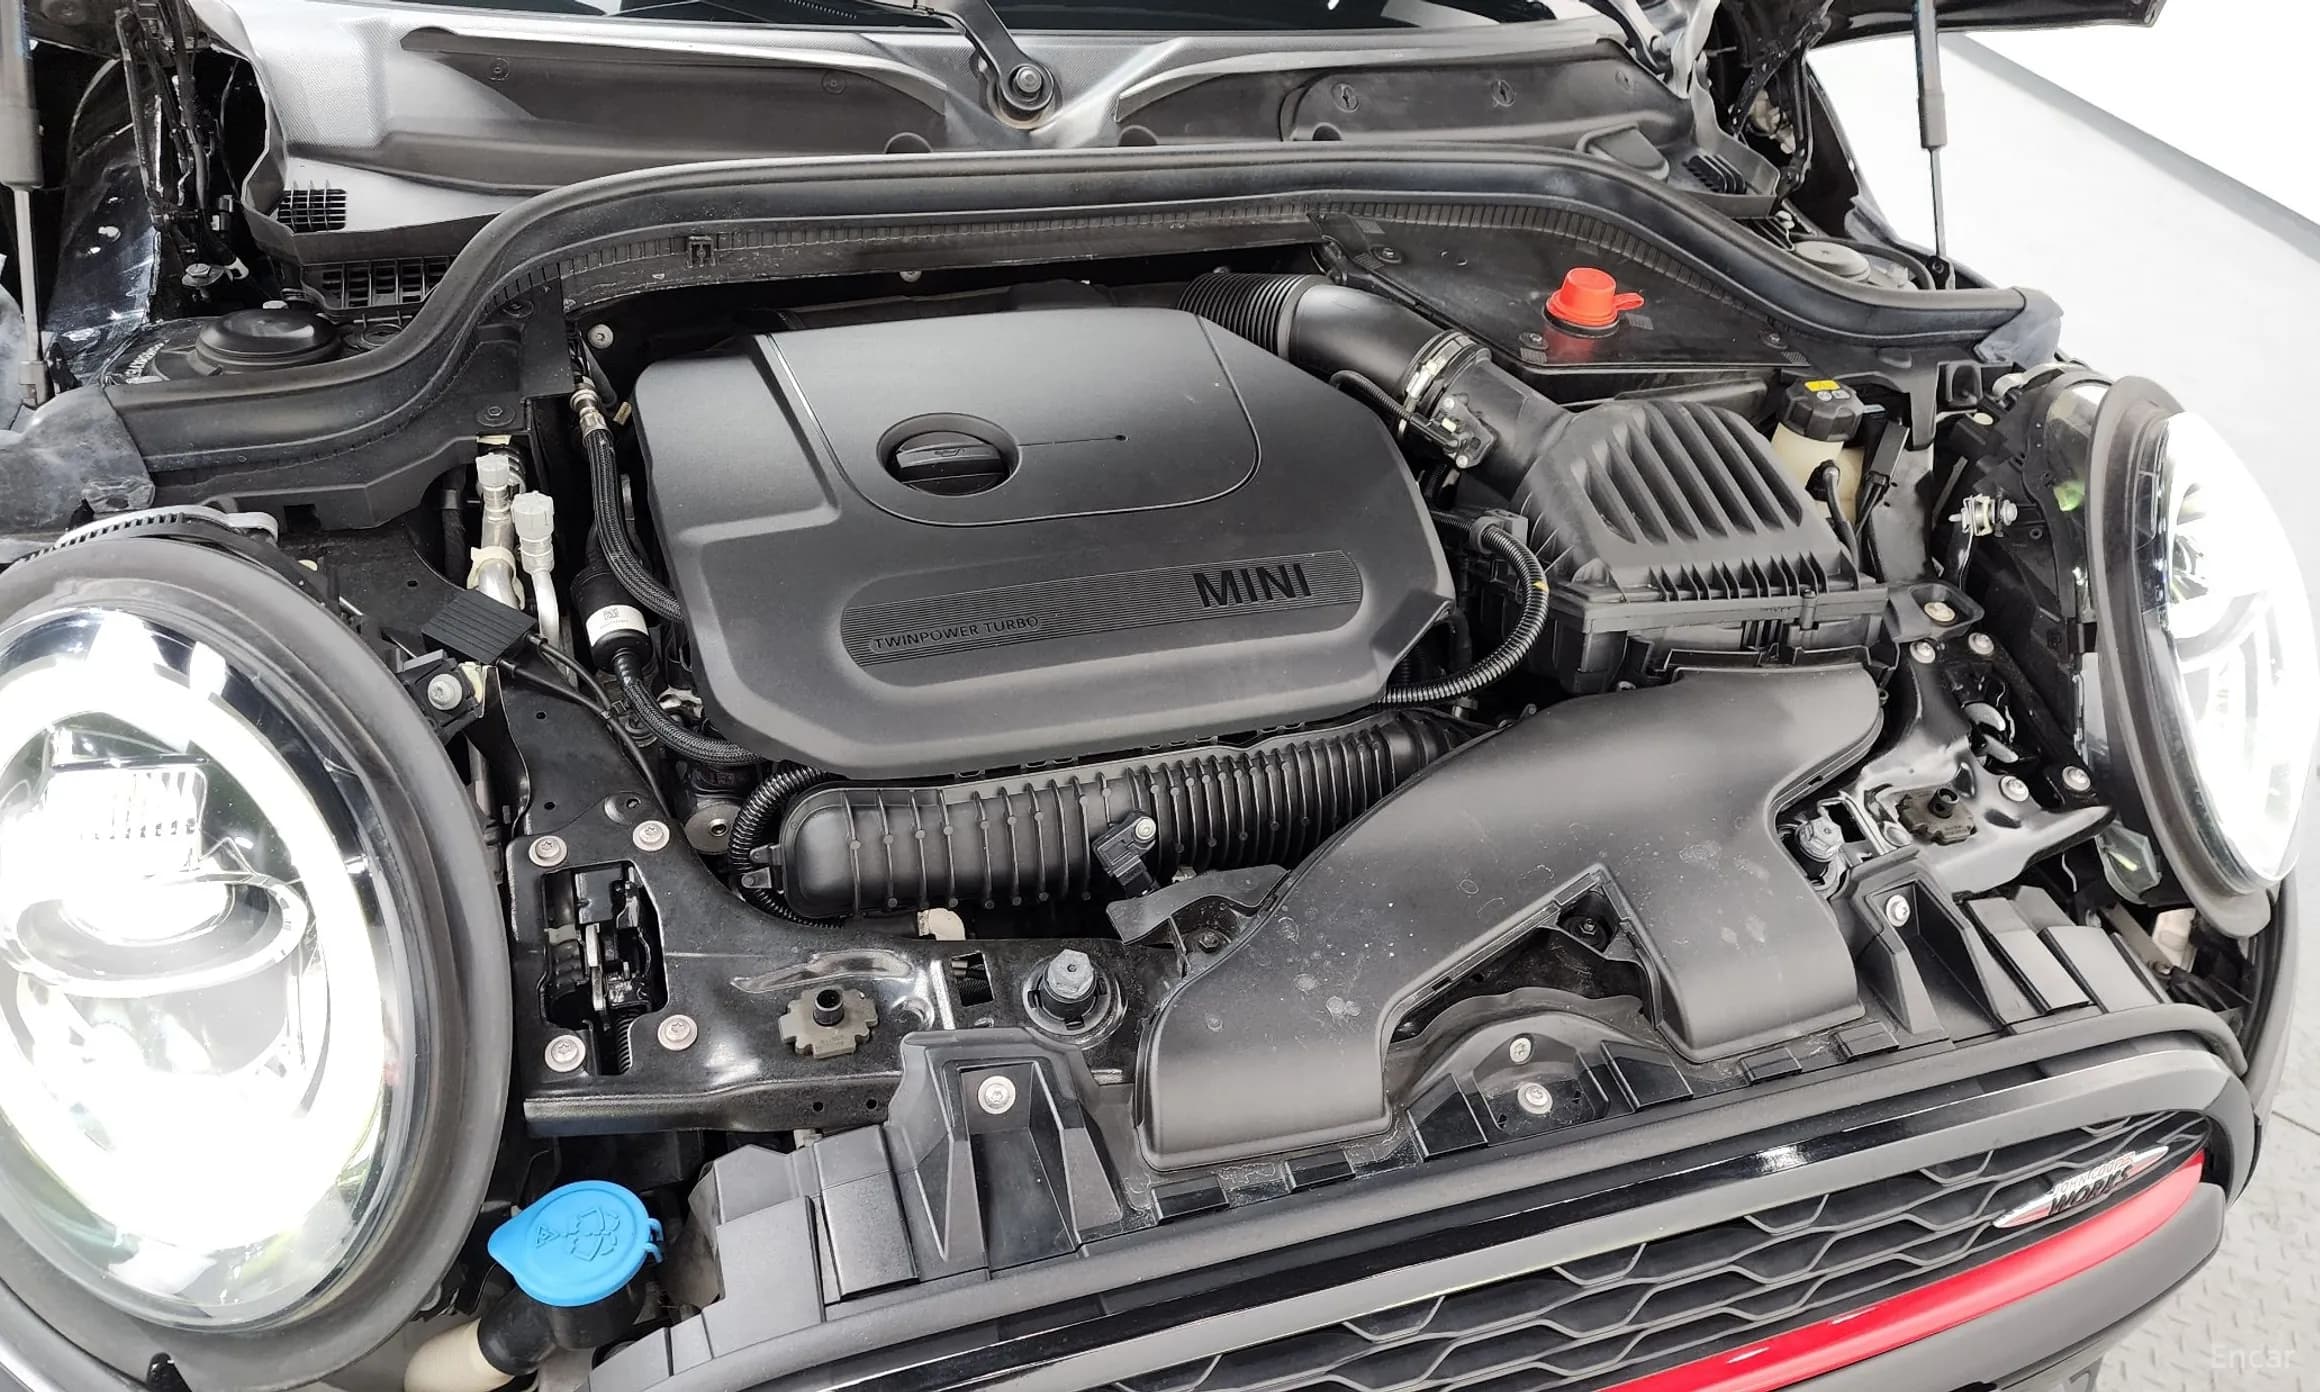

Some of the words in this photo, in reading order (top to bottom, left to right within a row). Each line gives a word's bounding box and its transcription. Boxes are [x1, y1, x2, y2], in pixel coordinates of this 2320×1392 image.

[1193, 563, 1312, 607] MINI
[874, 624, 979, 649] TWINPOWER
[983, 615, 1039, 634] TURBO
[2048, 1164, 2133, 1215] WORKS
